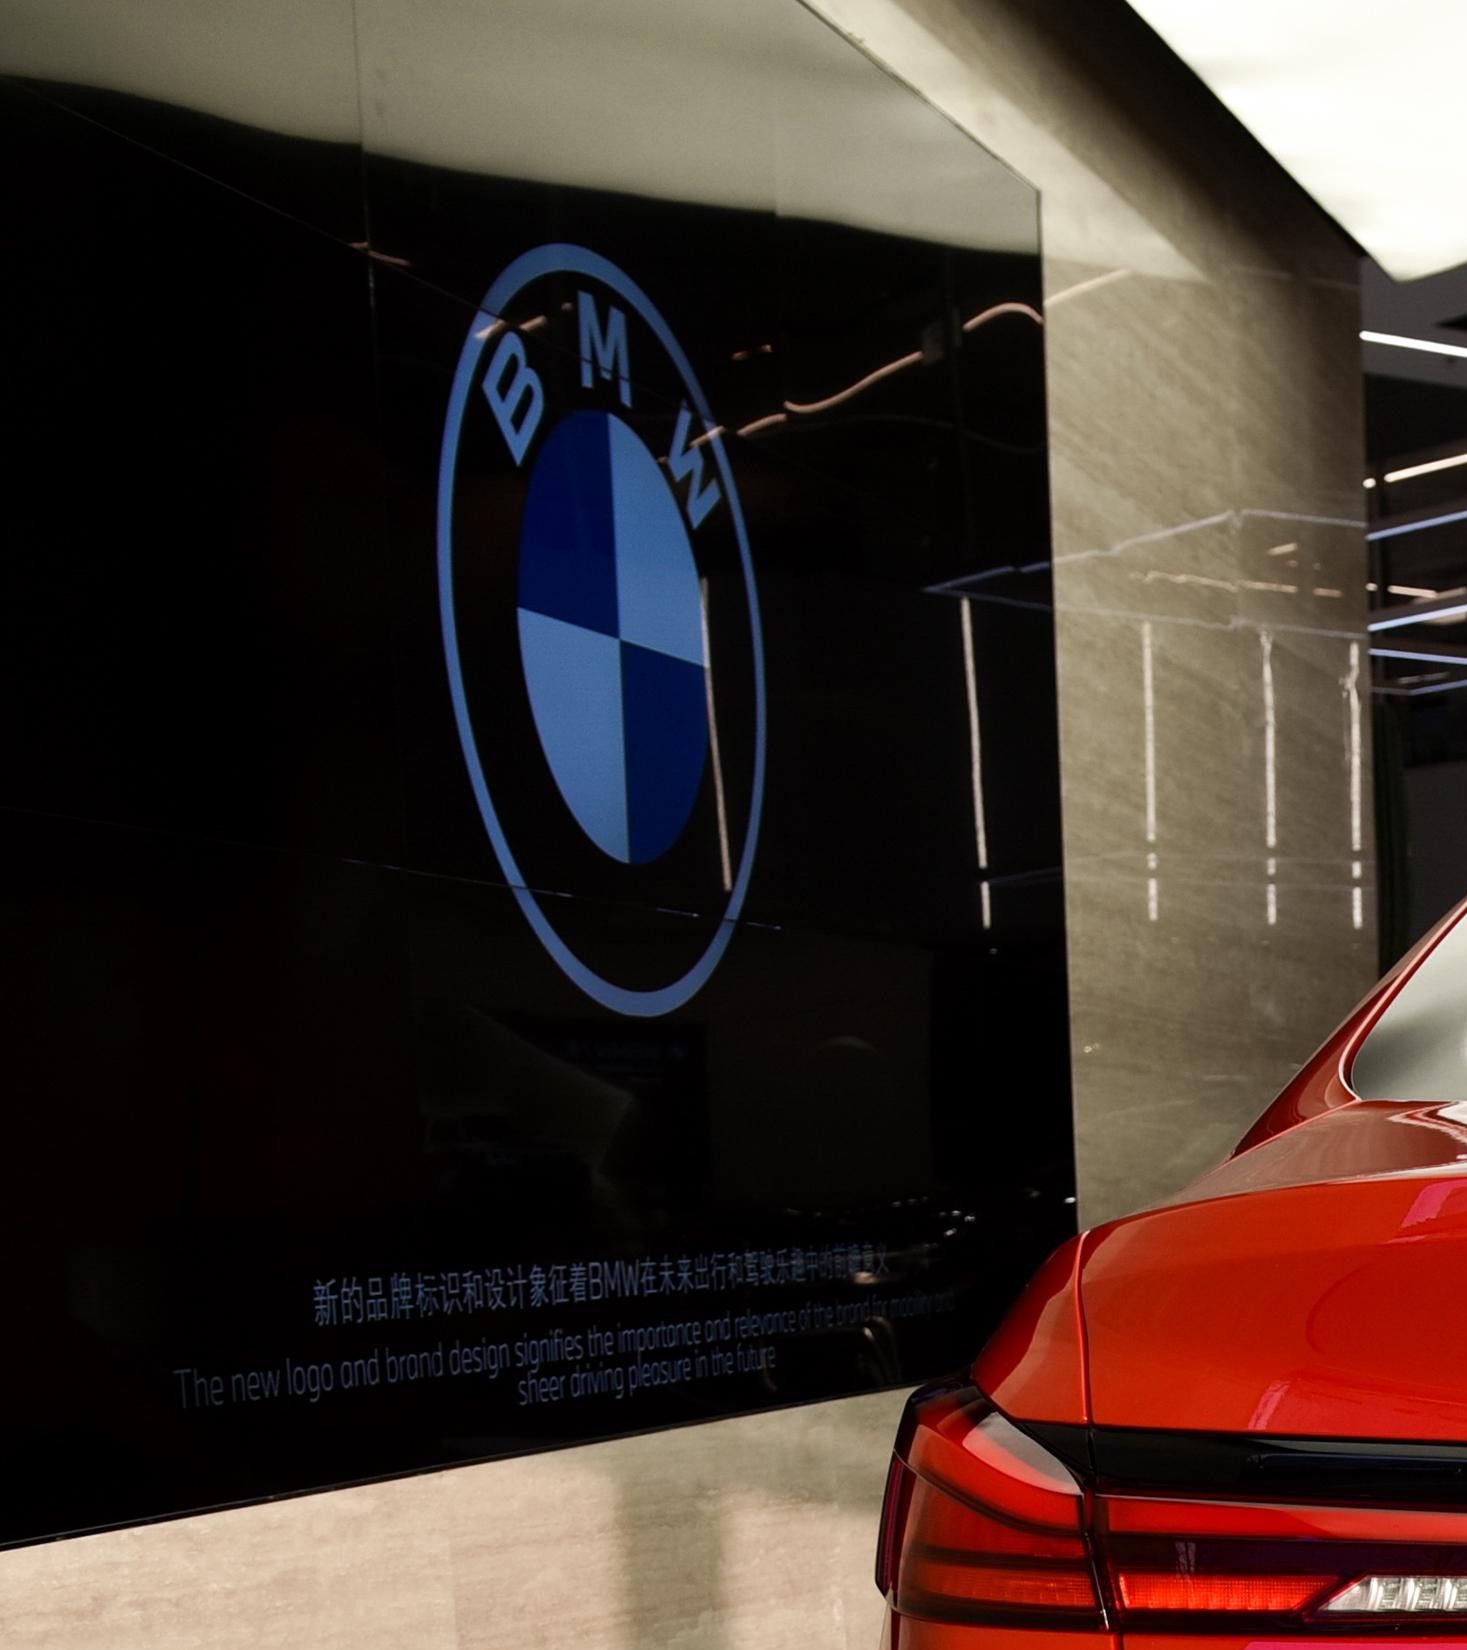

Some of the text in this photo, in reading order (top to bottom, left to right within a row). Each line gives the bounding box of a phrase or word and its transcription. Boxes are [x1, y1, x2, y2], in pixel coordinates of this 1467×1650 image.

[483, 290, 721, 529] BMW
[172, 1368, 224, 1410] The
[231, 1368, 280, 1403] new
[286, 1357, 334, 1403] logo
[339, 1347, 380, 1389] and
[385, 1340, 444, 1384] brand
[448, 1336, 511, 1379] design
[514, 1328, 583, 1374] signifies
[587, 1322, 614, 1358] the
[617, 1320, 702, 1364] importance
[705, 1311, 731, 1342] and
[735, 1308, 797, 1339] relevance
[517, 1342, 776, 1406] sheer driving pleasure in the future
